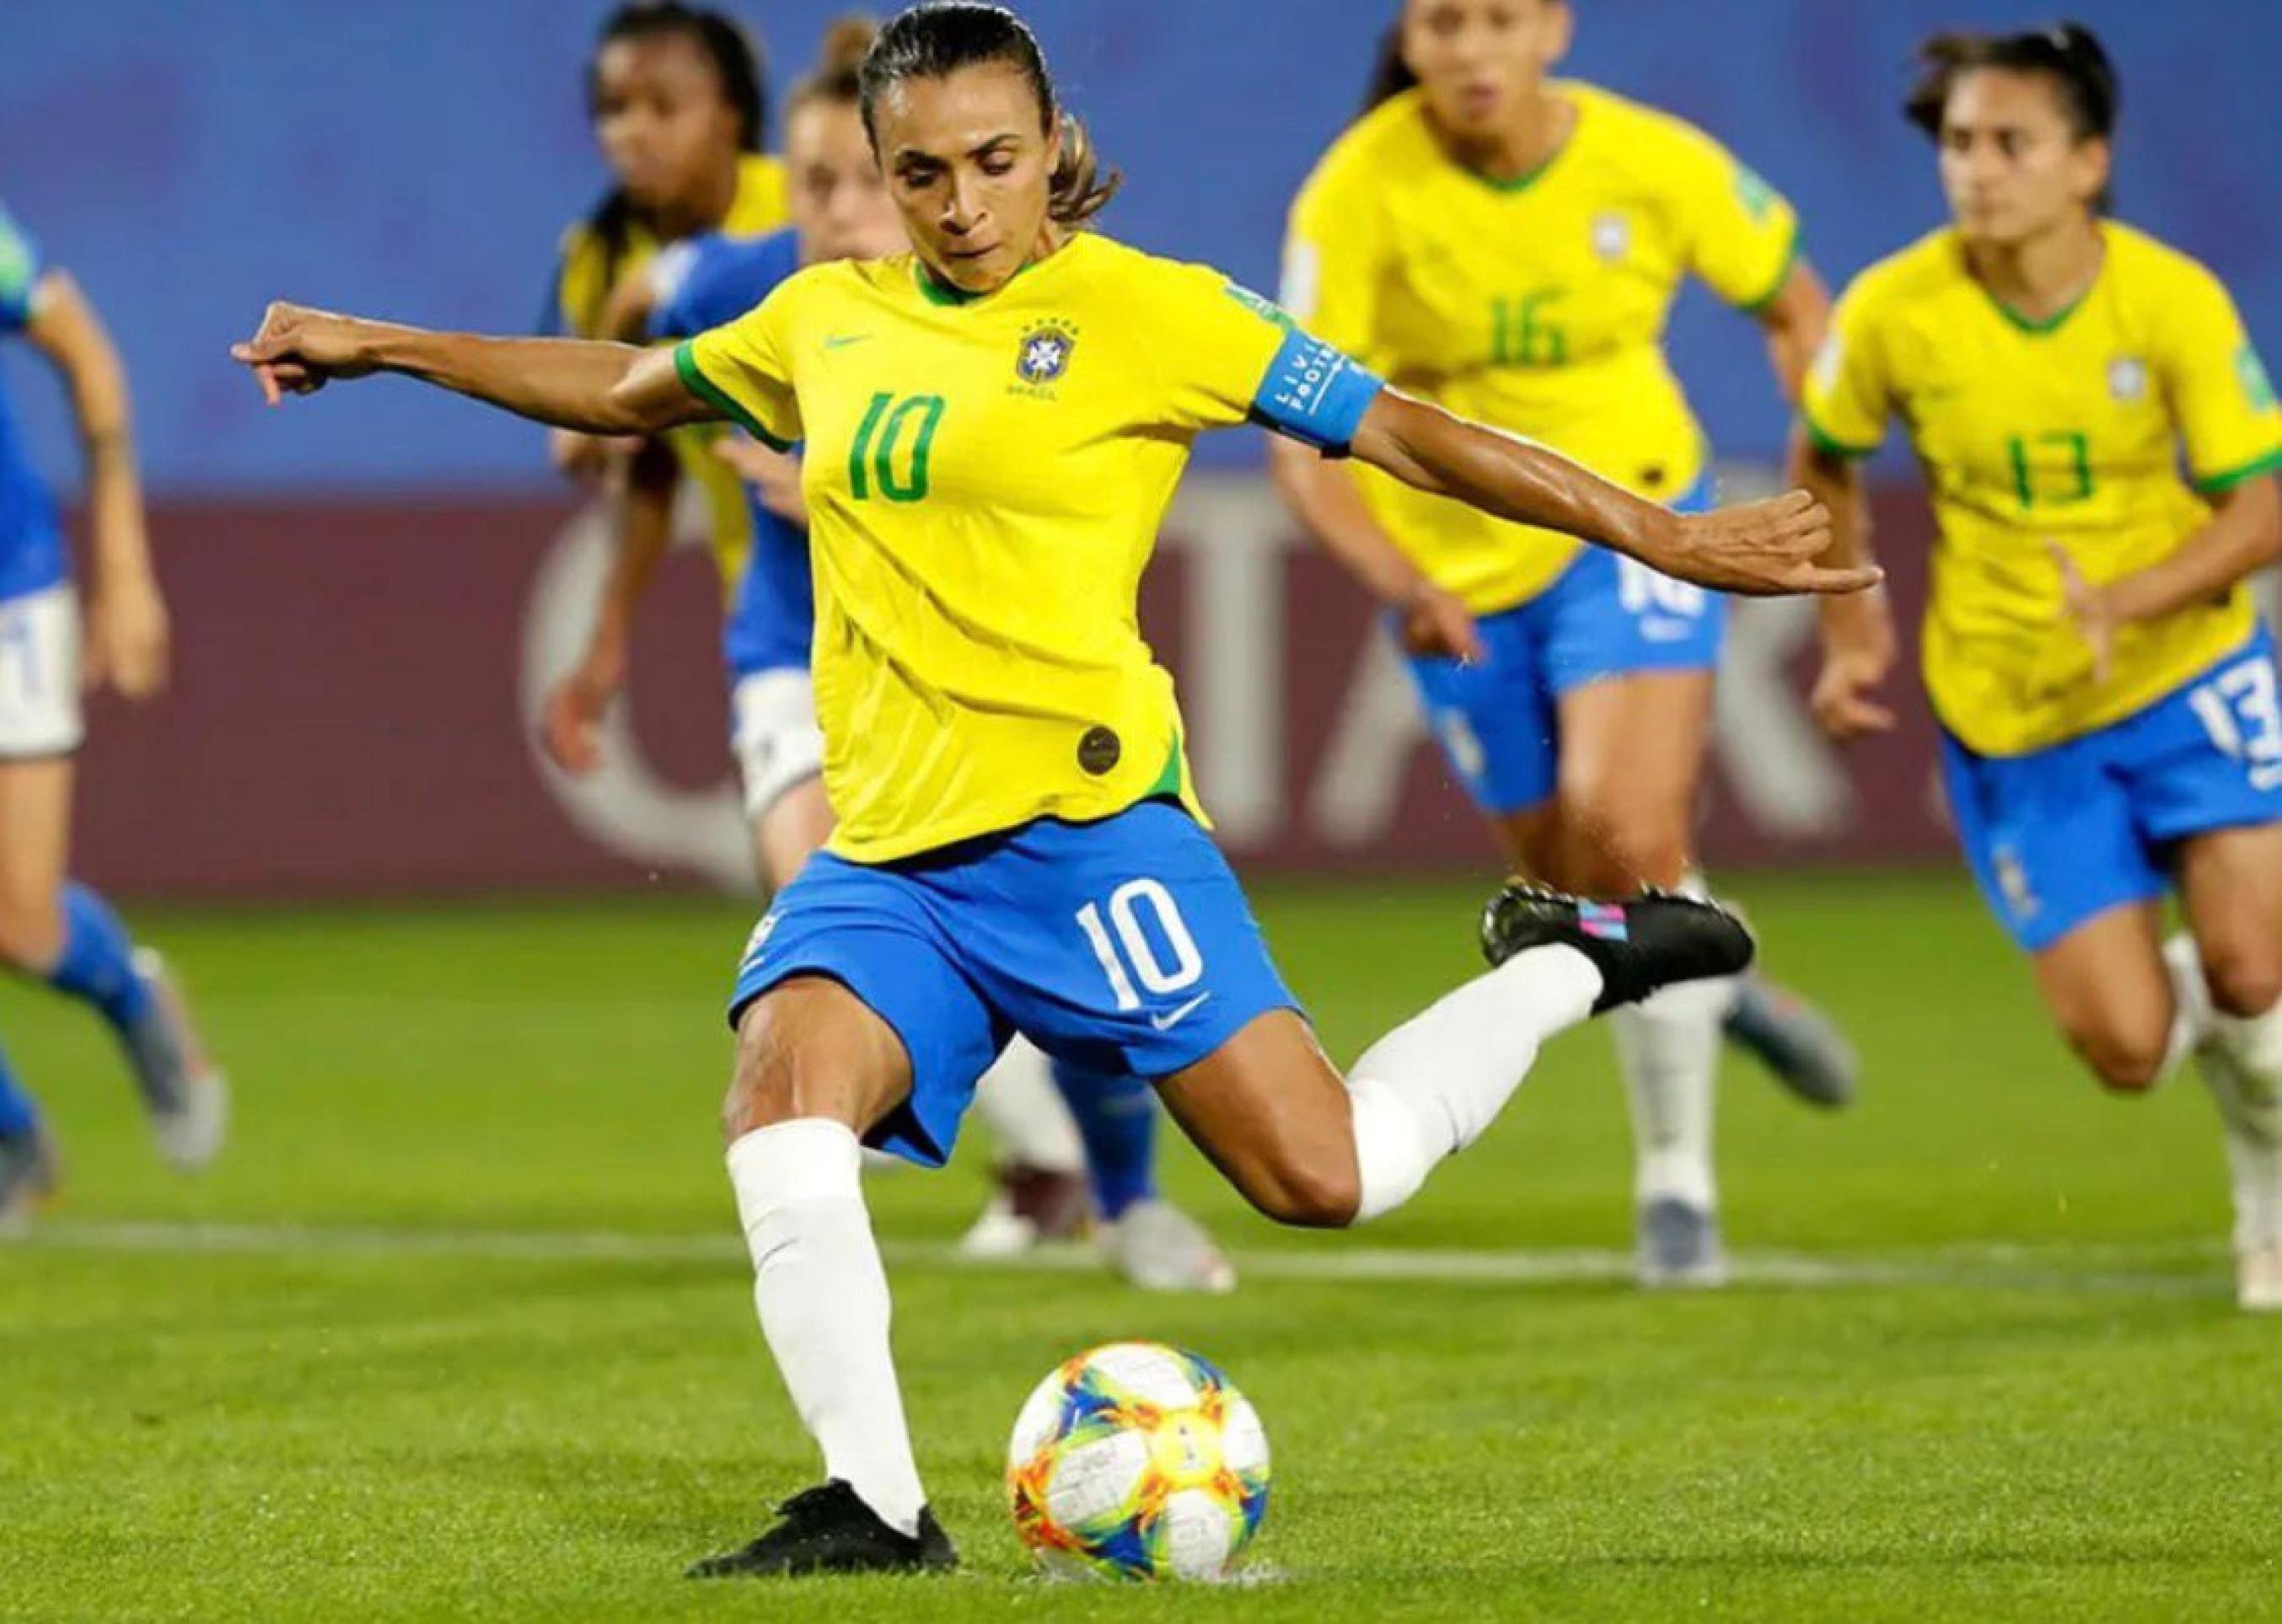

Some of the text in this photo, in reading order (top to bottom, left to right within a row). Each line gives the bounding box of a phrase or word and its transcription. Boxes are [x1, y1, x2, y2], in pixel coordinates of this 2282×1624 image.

[1491, 285, 1568, 367] 16
[850, 392, 944, 501] 10
[2008, 431, 2095, 509] 13
[2188, 656, 2282, 758] 13
[1075, 877, 1202, 1010] 10
